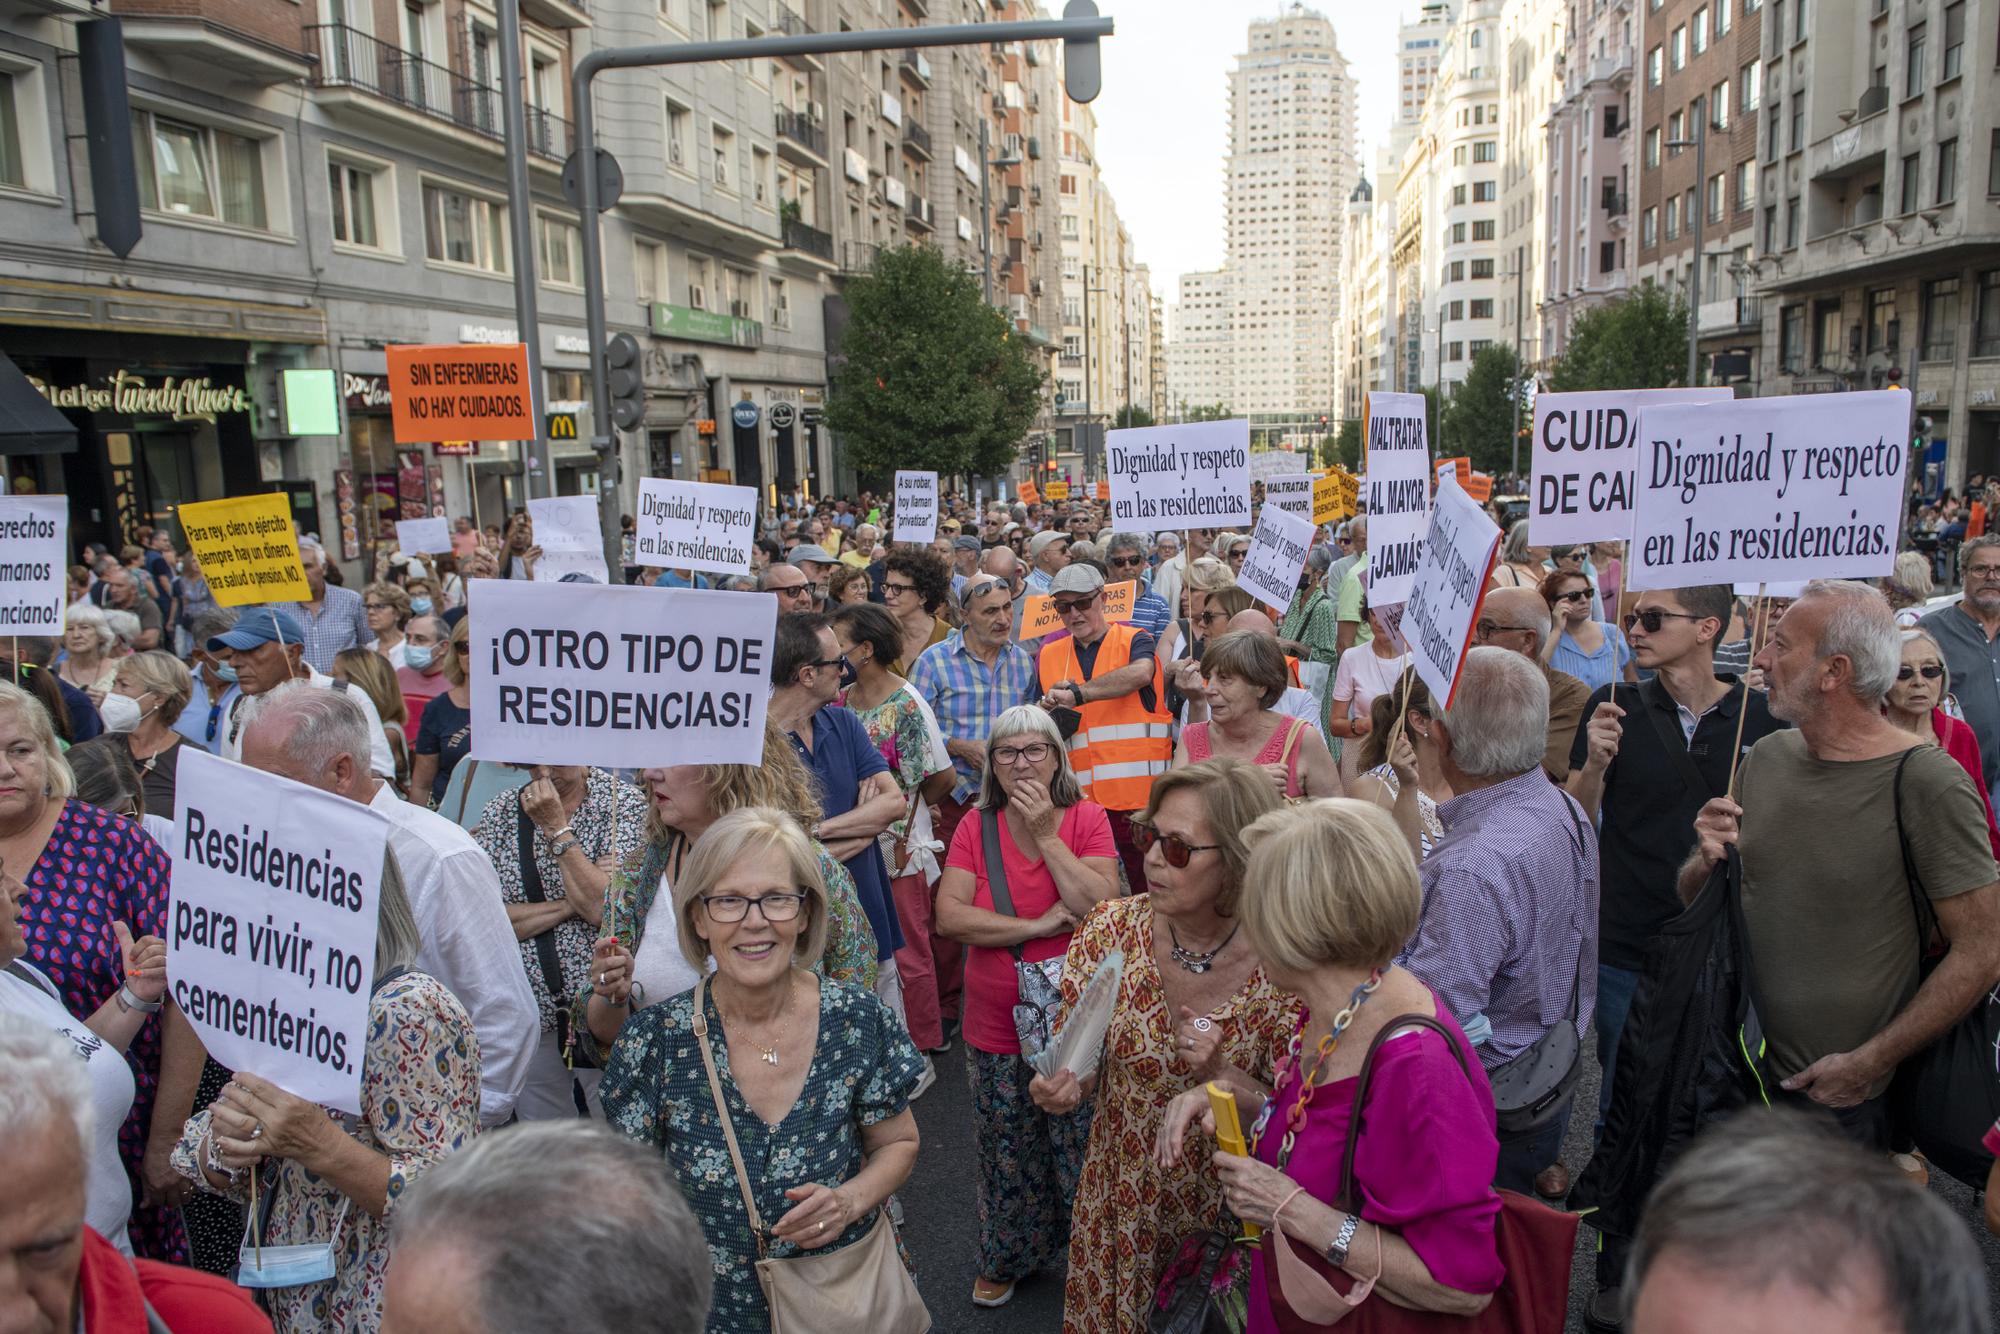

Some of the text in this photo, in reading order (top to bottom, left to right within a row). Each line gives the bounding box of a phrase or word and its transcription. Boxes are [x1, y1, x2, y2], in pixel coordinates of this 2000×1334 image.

[410, 362, 518, 385] SIN ENFERMERAS
[409, 395, 526, 418] NO HAY CUIDADOS.
[1368, 416, 1424, 450] MALTRATAR
[1111, 443, 1177, 483] Dignidad
[1180, 452, 1189, 480] y
[1193, 444, 1245, 479] respeto
[1649, 432, 1901, 504] Dignidad y respeto
[898, 475, 932, 491] A su robar,
[1266, 481, 1309, 494] MALTRATAR
[1320, 488, 1331, 500] TIPO
[1368, 481, 1384, 516] AL
[1387, 478, 1426, 518] MAYOR,
[1539, 469, 1634, 515] DE CA
[642, 492, 751, 533] Dignidad y respeto
[897, 495, 932, 511] hoy llaman
[1115, 485, 1248, 519] en las residencias.
[1280, 500, 1309, 513] MAYOR,
[186, 514, 287, 542] Para rey, clero o ejército
[1254, 516, 1307, 569] Dignidad y respeto
[1644, 509, 1890, 568] en las residencias.
[197, 542, 294, 567] siempre hay un dinero.
[640, 531, 747, 565] en las residencias.
[1368, 533, 1426, 590] ¡JAMÁS
[1427, 502, 1459, 573] Dignidad
[1449, 553, 1477, 610] respeto
[205, 565, 303, 589] Para salud o pensión, NO.
[1035, 615, 1050, 628] NO
[492, 628, 763, 675] ¡OTRO TIPO DE
[499, 685, 752, 730] RESIDENCIAS!
[184, 807, 363, 913] Residencias
[174, 899, 362, 994] para vivir, no
[174, 979, 353, 1075] cementerios.
